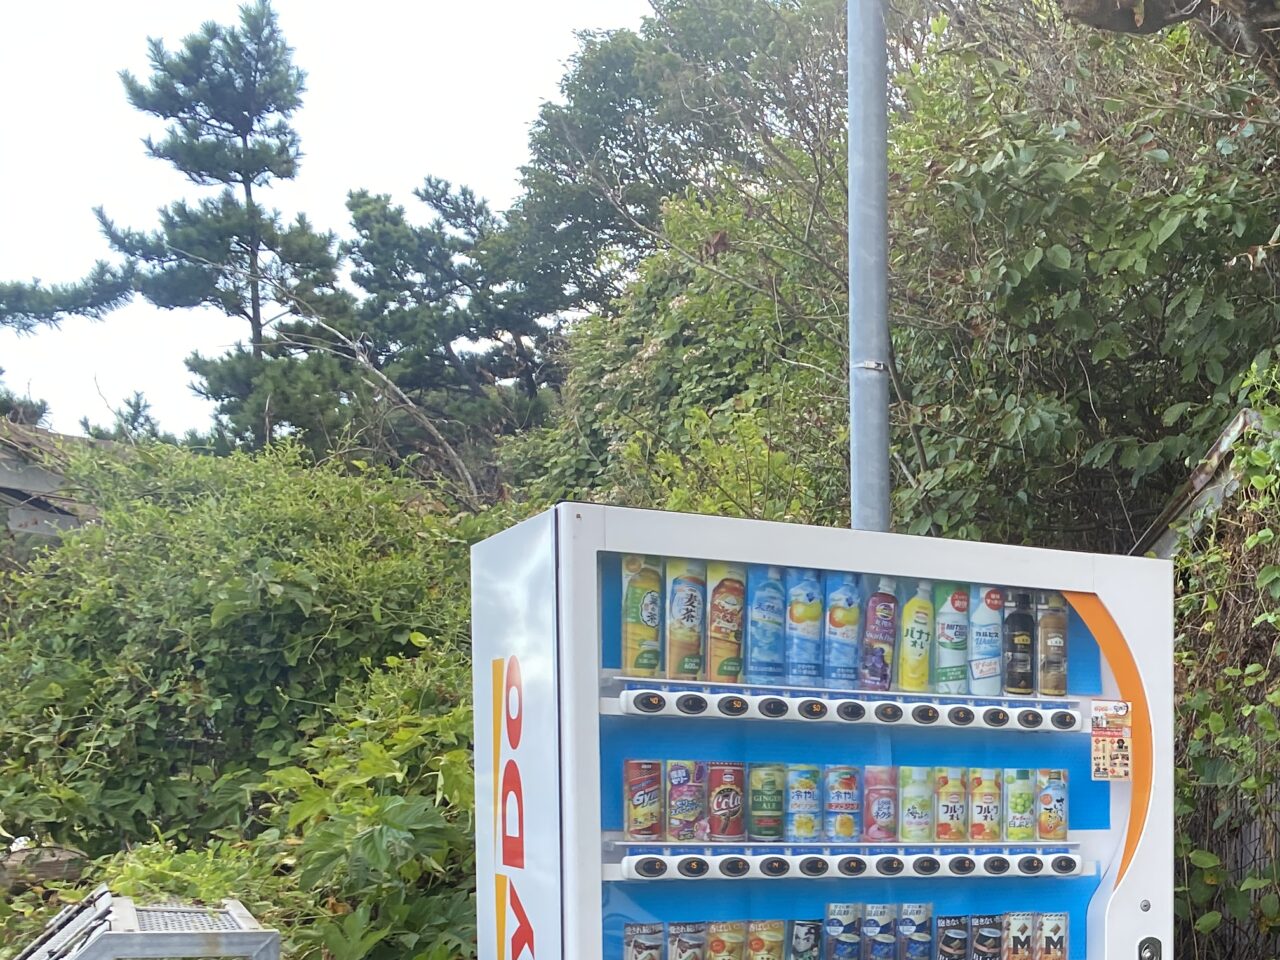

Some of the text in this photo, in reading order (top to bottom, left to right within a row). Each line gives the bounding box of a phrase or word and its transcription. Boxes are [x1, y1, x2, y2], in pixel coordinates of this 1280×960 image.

[682, 594, 697, 623] 麦茶
[904, 627, 930, 641] バナナ
[713, 794, 742, 811] Cola
[791, 791, 817, 800] 冷やし
[831, 791, 856, 801] 冷やし
[1012, 936, 1031, 954] M
[1045, 936, 1064, 954] M
